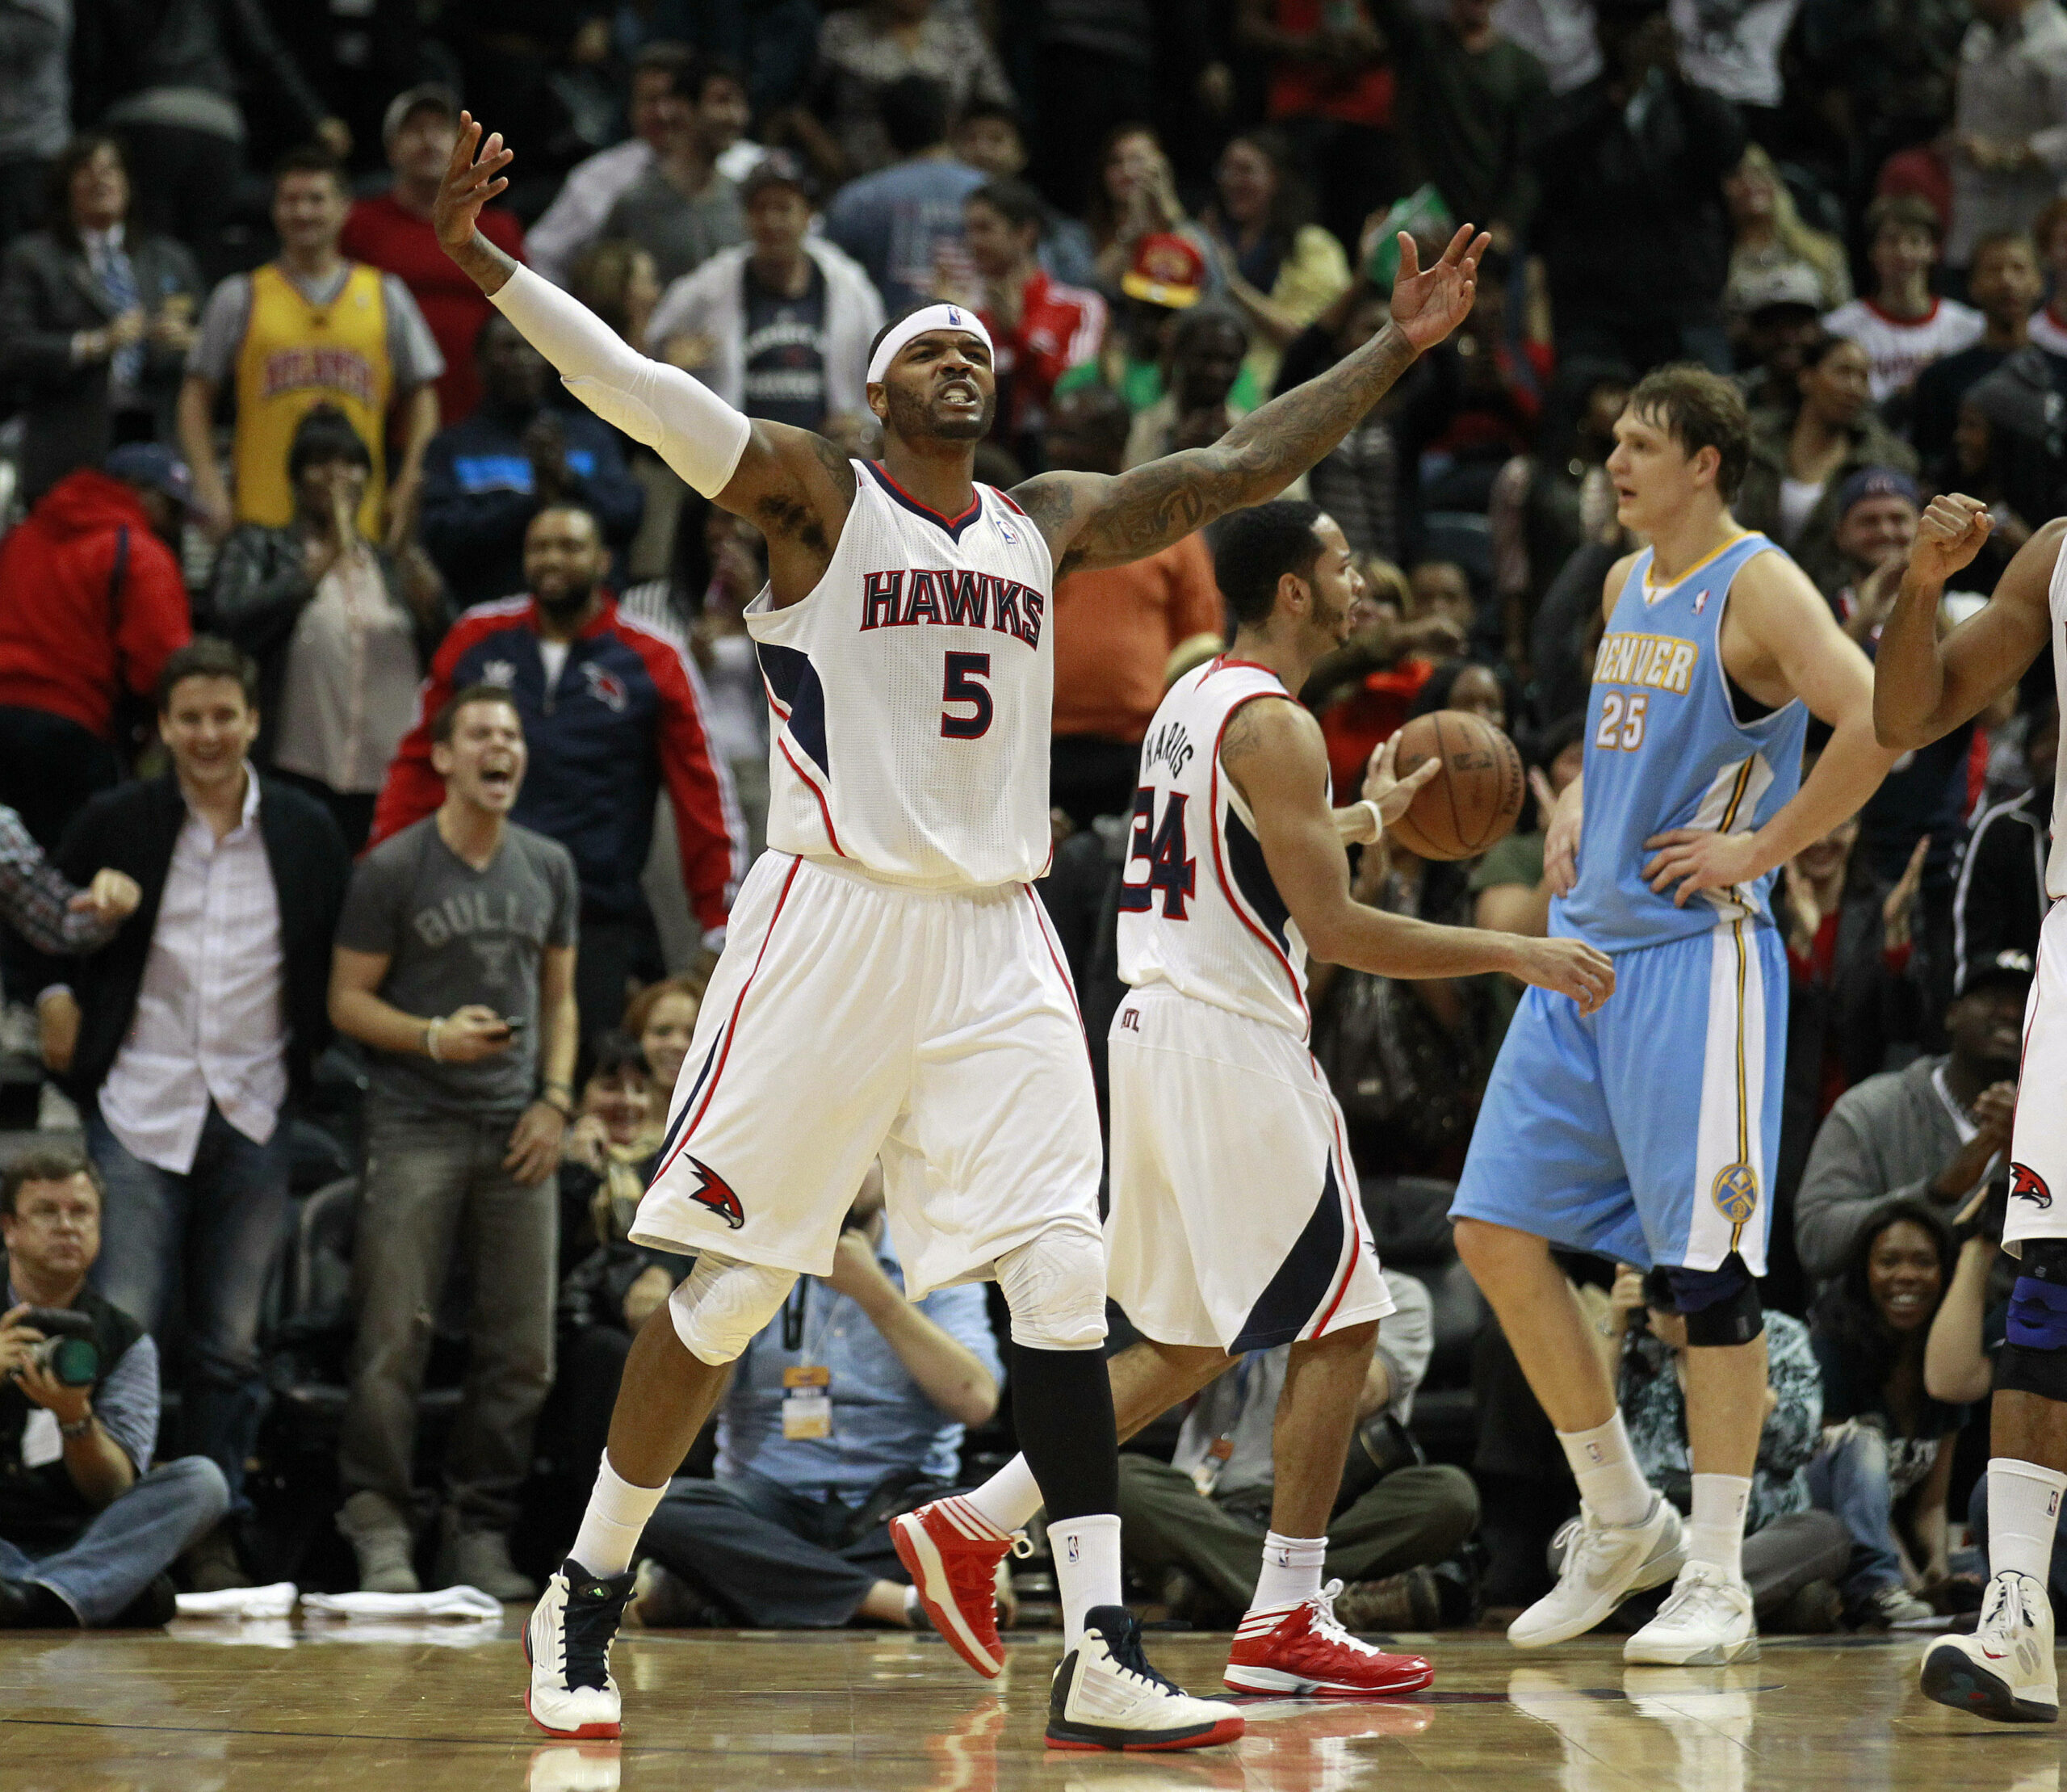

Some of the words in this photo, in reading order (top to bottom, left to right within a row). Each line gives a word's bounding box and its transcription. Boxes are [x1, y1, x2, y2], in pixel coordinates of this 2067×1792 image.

[859, 569, 1045, 652] HAWKS
[941, 651, 993, 740] 5
[1592, 631, 1699, 695] DENVER
[1146, 722, 1194, 779] HARRIS
[1596, 690, 1650, 752] 25
[1117, 786, 1196, 921] 34
